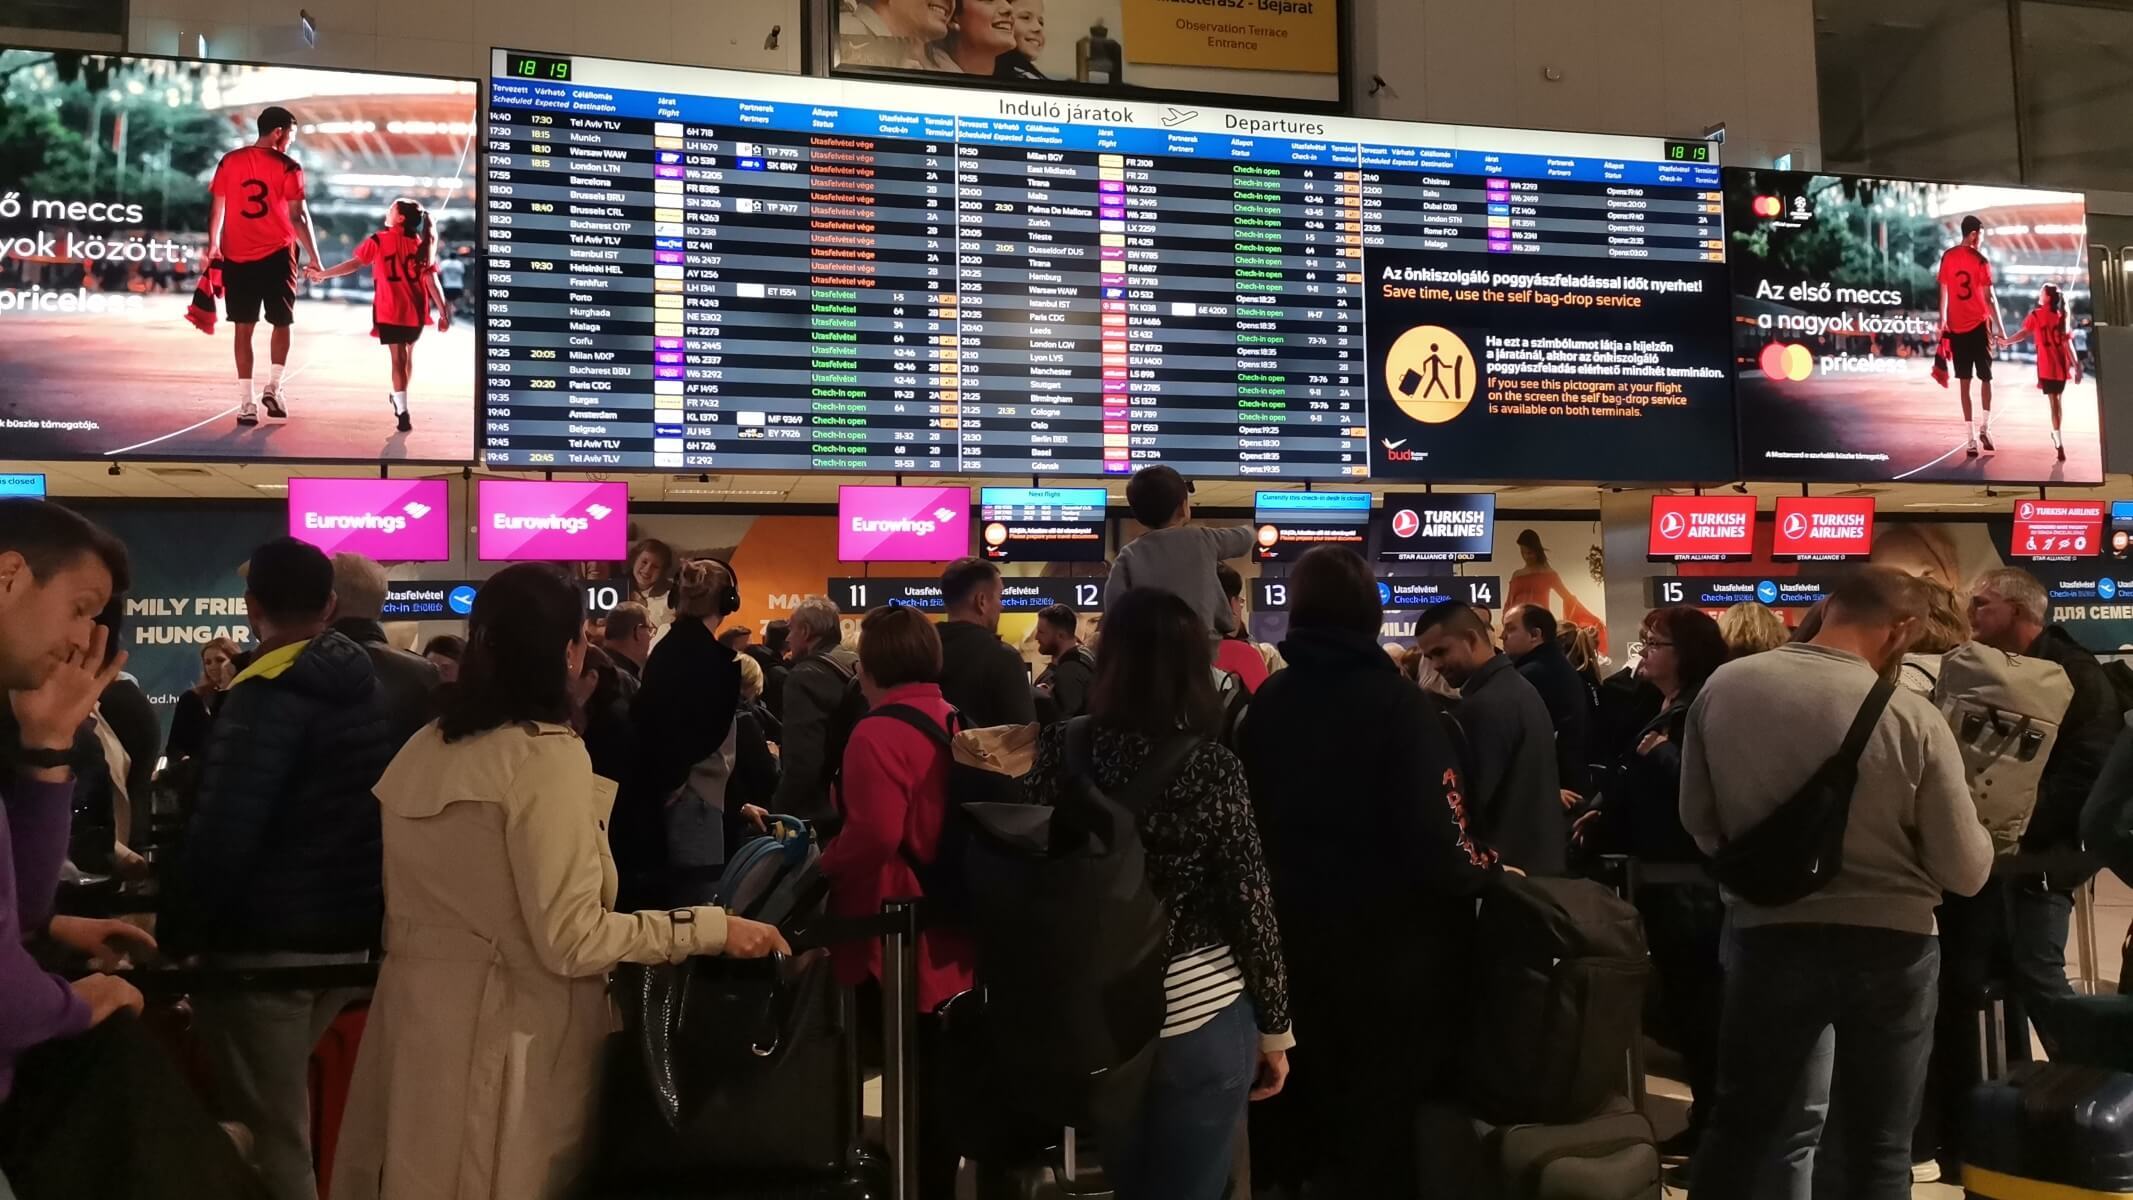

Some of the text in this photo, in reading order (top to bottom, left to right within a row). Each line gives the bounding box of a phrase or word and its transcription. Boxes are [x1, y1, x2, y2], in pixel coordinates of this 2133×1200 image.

[1176, 18, 1288, 39] Observation Terrace
[1207, 36, 1257, 51] Entrance
[518, 60, 568, 79] 18 19
[492, 95, 616, 112] Scheduled Expected Destination
[489, 112, 621, 130] 14:40 17:30 Tel TLV
[999, 99, 1325, 136] Induló járatok Departures
[569, 133, 601, 143] Munich
[810, 137, 874, 150] Utasfelvétel vége
[810, 151, 874, 164] Utasfelvétel vége
[1671, 146, 1706, 160] 18 19
[569, 162, 602, 172] London
[1233, 165, 1281, 176] Check-in open
[569, 176, 611, 187] Barcelona
[240, 179, 269, 219] 3
[32, 199, 144, 224] meccs
[1424, 214, 1448, 224] London
[67, 231, 189, 264] között:
[1067, 247, 1084, 256] DUS
[384, 252, 420, 283] 10
[488, 274, 609, 288] 19:05 Frankfurt
[1382, 267, 1704, 296] Az önkiszolgáló poggyászfeladással időt nyerhet!
[1955, 270, 1972, 301] 3
[569, 293, 593, 302] Porto
[1383, 284, 1642, 308] Save time, use the self bag-drop service
[1756, 279, 1902, 305] Az első meccs
[569, 307, 611, 318] Hurghada
[812, 304, 857, 314] Utasfelvétel
[488, 318, 601, 332] 19:20 Malaga
[1758, 311, 1931, 336] a nagyok között:
[569, 337, 593, 346] Corfu
[1486, 335, 1674, 355] Ha ezt a szimbólumot látja a kijelzőn
[569, 351, 593, 360] Milan
[594, 352, 615, 361] MXP
[1030, 353, 1048, 363] Lyon
[1486, 349, 1660, 366] a járatánál, akkor az önkiszolgáló
[1487, 361, 1725, 379] poggyászfeladás elérhető mindkét terminálon.
[1820, 351, 1908, 376] priceless
[1030, 367, 1286, 382] Manchester Check-in open
[812, 388, 867, 400] Check-in open
[1488, 378, 1682, 396] If you see this pictogram at your flight
[1488, 390, 1688, 407] on the screen the self bag-drop service
[568, 410, 618, 420] Amsterdam
[1488, 402, 1643, 417] is available on both terminals.
[6, 418, 40, 429] büszke
[41, 419, 100, 431] támogatója.
[569, 425, 607, 435] Belgrade
[1387, 448, 1411, 462] bud
[8, 476, 36, 486] closed
[1262, 494, 1288, 502] Currently
[1289, 494, 1300, 502] this
[1423, 510, 1485, 523] TURKISH
[2036, 507, 2100, 517] TURKISH AIRLINES
[305, 511, 407, 534] Eurowings
[493, 512, 589, 534] Eurowings
[852, 516, 936, 537] Eurowings
[1690, 513, 1746, 526] TURKISH
[1811, 513, 1865, 526] TURKISH
[1422, 524, 1485, 537] AIRLINES
[1687, 526, 1745, 538] AIRLINES
[1809, 526, 1864, 539] AIRLINES
[849, 584, 866, 608] 11
[904, 587, 943, 598] Utasfelv
[1001, 586, 1040, 597] sfelvétel
[1075, 584, 1099, 606] 12
[1264, 584, 1287, 606] 13
[1393, 585, 1439, 596] Utasfelvétel
[1469, 583, 1492, 604] 14
[1663, 582, 1684, 603] 15
[1713, 584, 1820, 595] Utasfelvétel Utasfelvétel
[2050, 590, 2078, 599] Check-in
[586, 586, 619, 611] 10
[1001, 598, 1028, 607] eck-in
[1394, 595, 1429, 605] Check-in
[1701, 593, 1733, 603] Check-in
[1781, 593, 1812, 602] Check-in
[126, 597, 249, 617] MILY FRIE
[383, 603, 410, 614] ck-in
[2053, 606, 2133, 623] ДЛЯ СЕМЕ
[135, 624, 250, 646] HUNGAR
